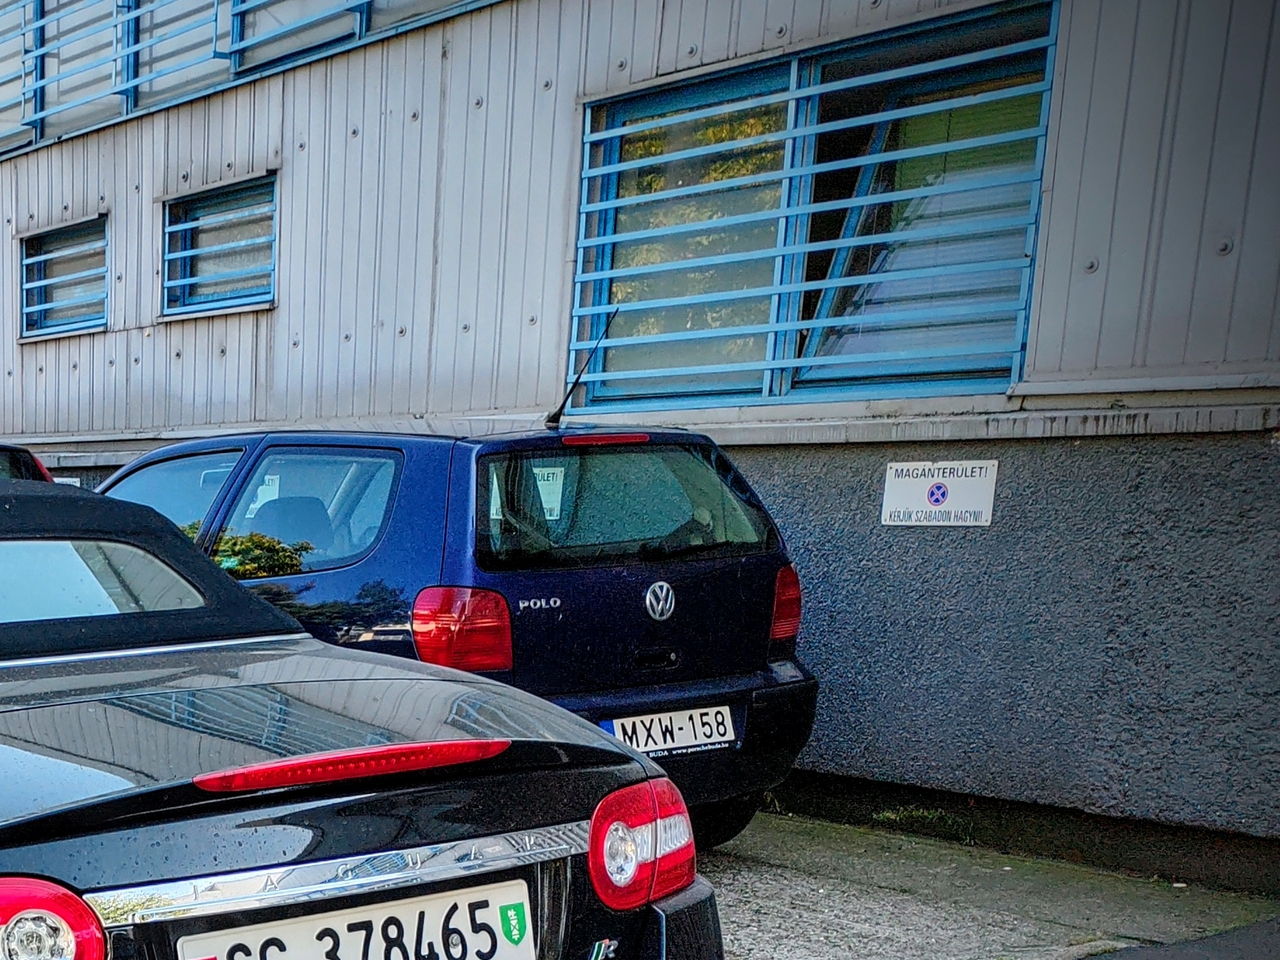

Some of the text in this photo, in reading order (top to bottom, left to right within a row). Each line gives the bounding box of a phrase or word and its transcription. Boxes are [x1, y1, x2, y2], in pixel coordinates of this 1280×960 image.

[894, 464, 988, 480] MAGÁNTERÜLET!
[889, 507, 915, 523] KÉRJÜK
[915, 509, 953, 523] SZABADON
[519, 597, 561, 610] POLO
[621, 710, 727, 748] MXW-158
[192, 834, 537, 901] JAGUAR
